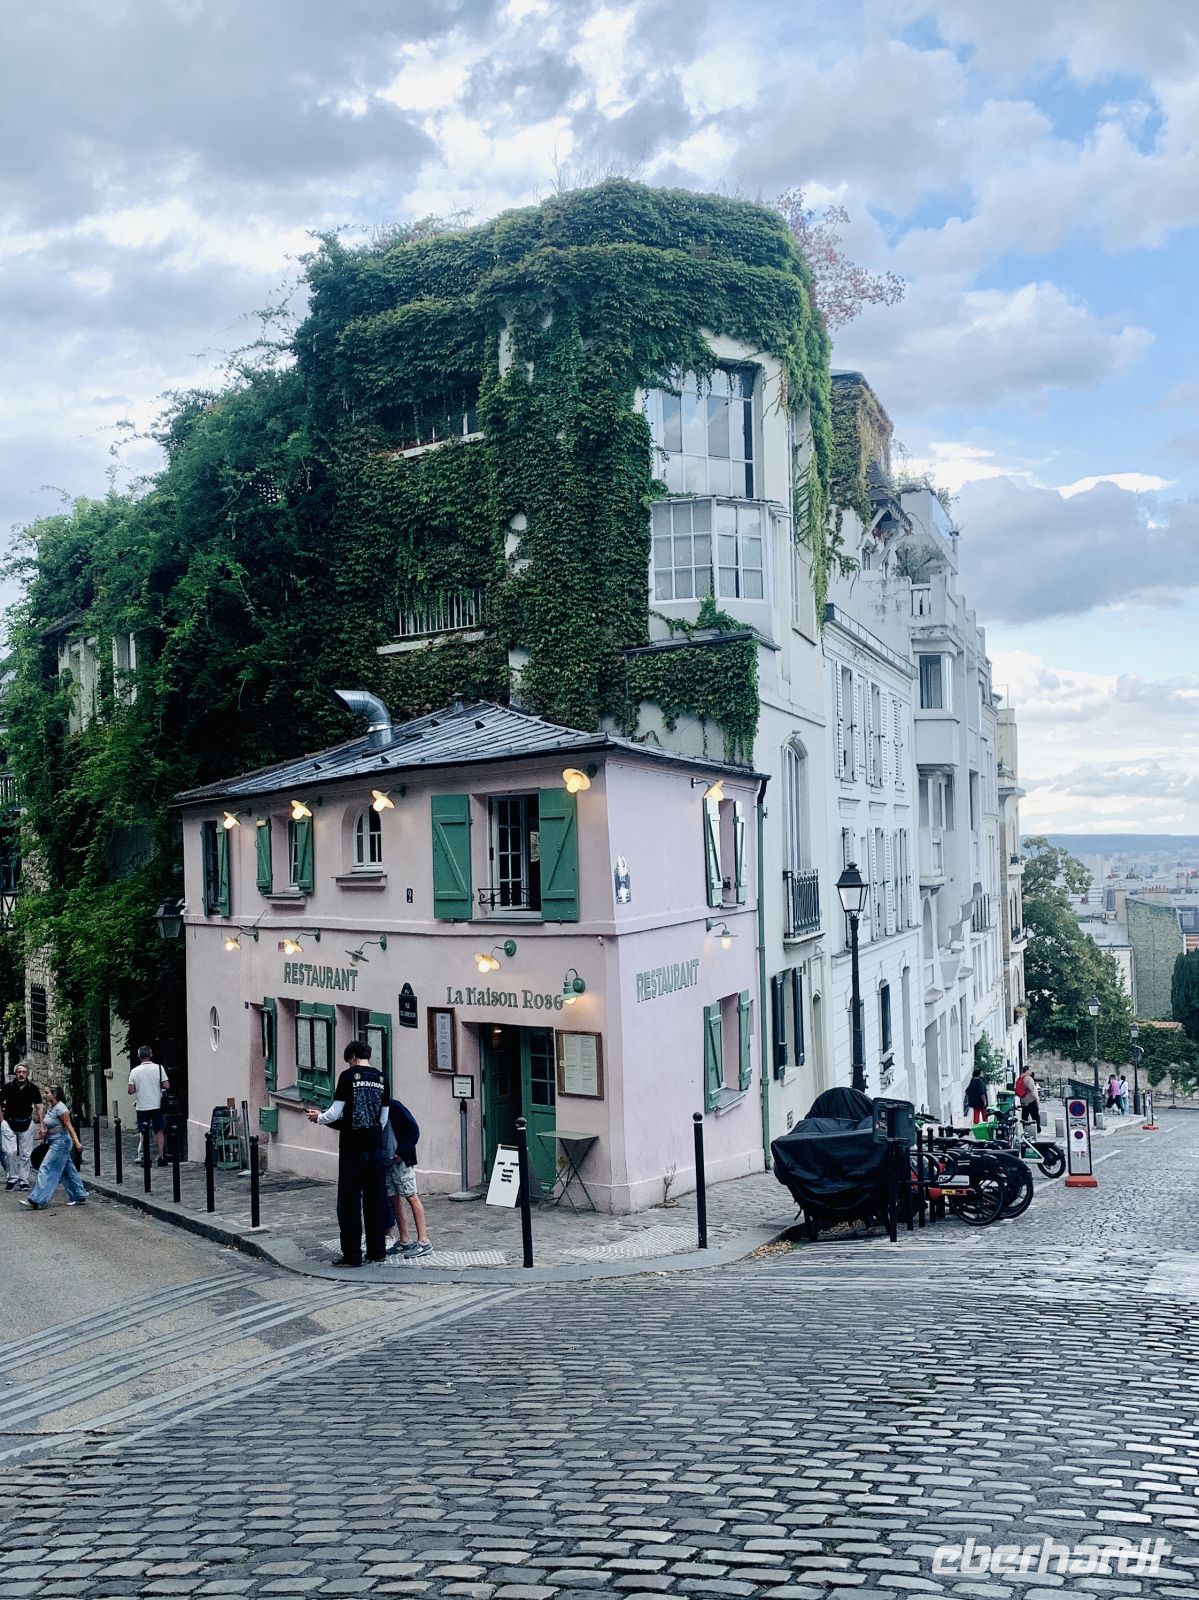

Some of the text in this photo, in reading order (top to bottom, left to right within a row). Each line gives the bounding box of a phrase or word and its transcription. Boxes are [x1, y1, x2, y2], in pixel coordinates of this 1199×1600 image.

[284, 962, 358, 992] RESTAURANT
[636, 959, 699, 1003] RESTAURANT
[446, 987, 564, 1010] La Maison Rose
[352, 1080, 385, 1090] LINKIN PARK
